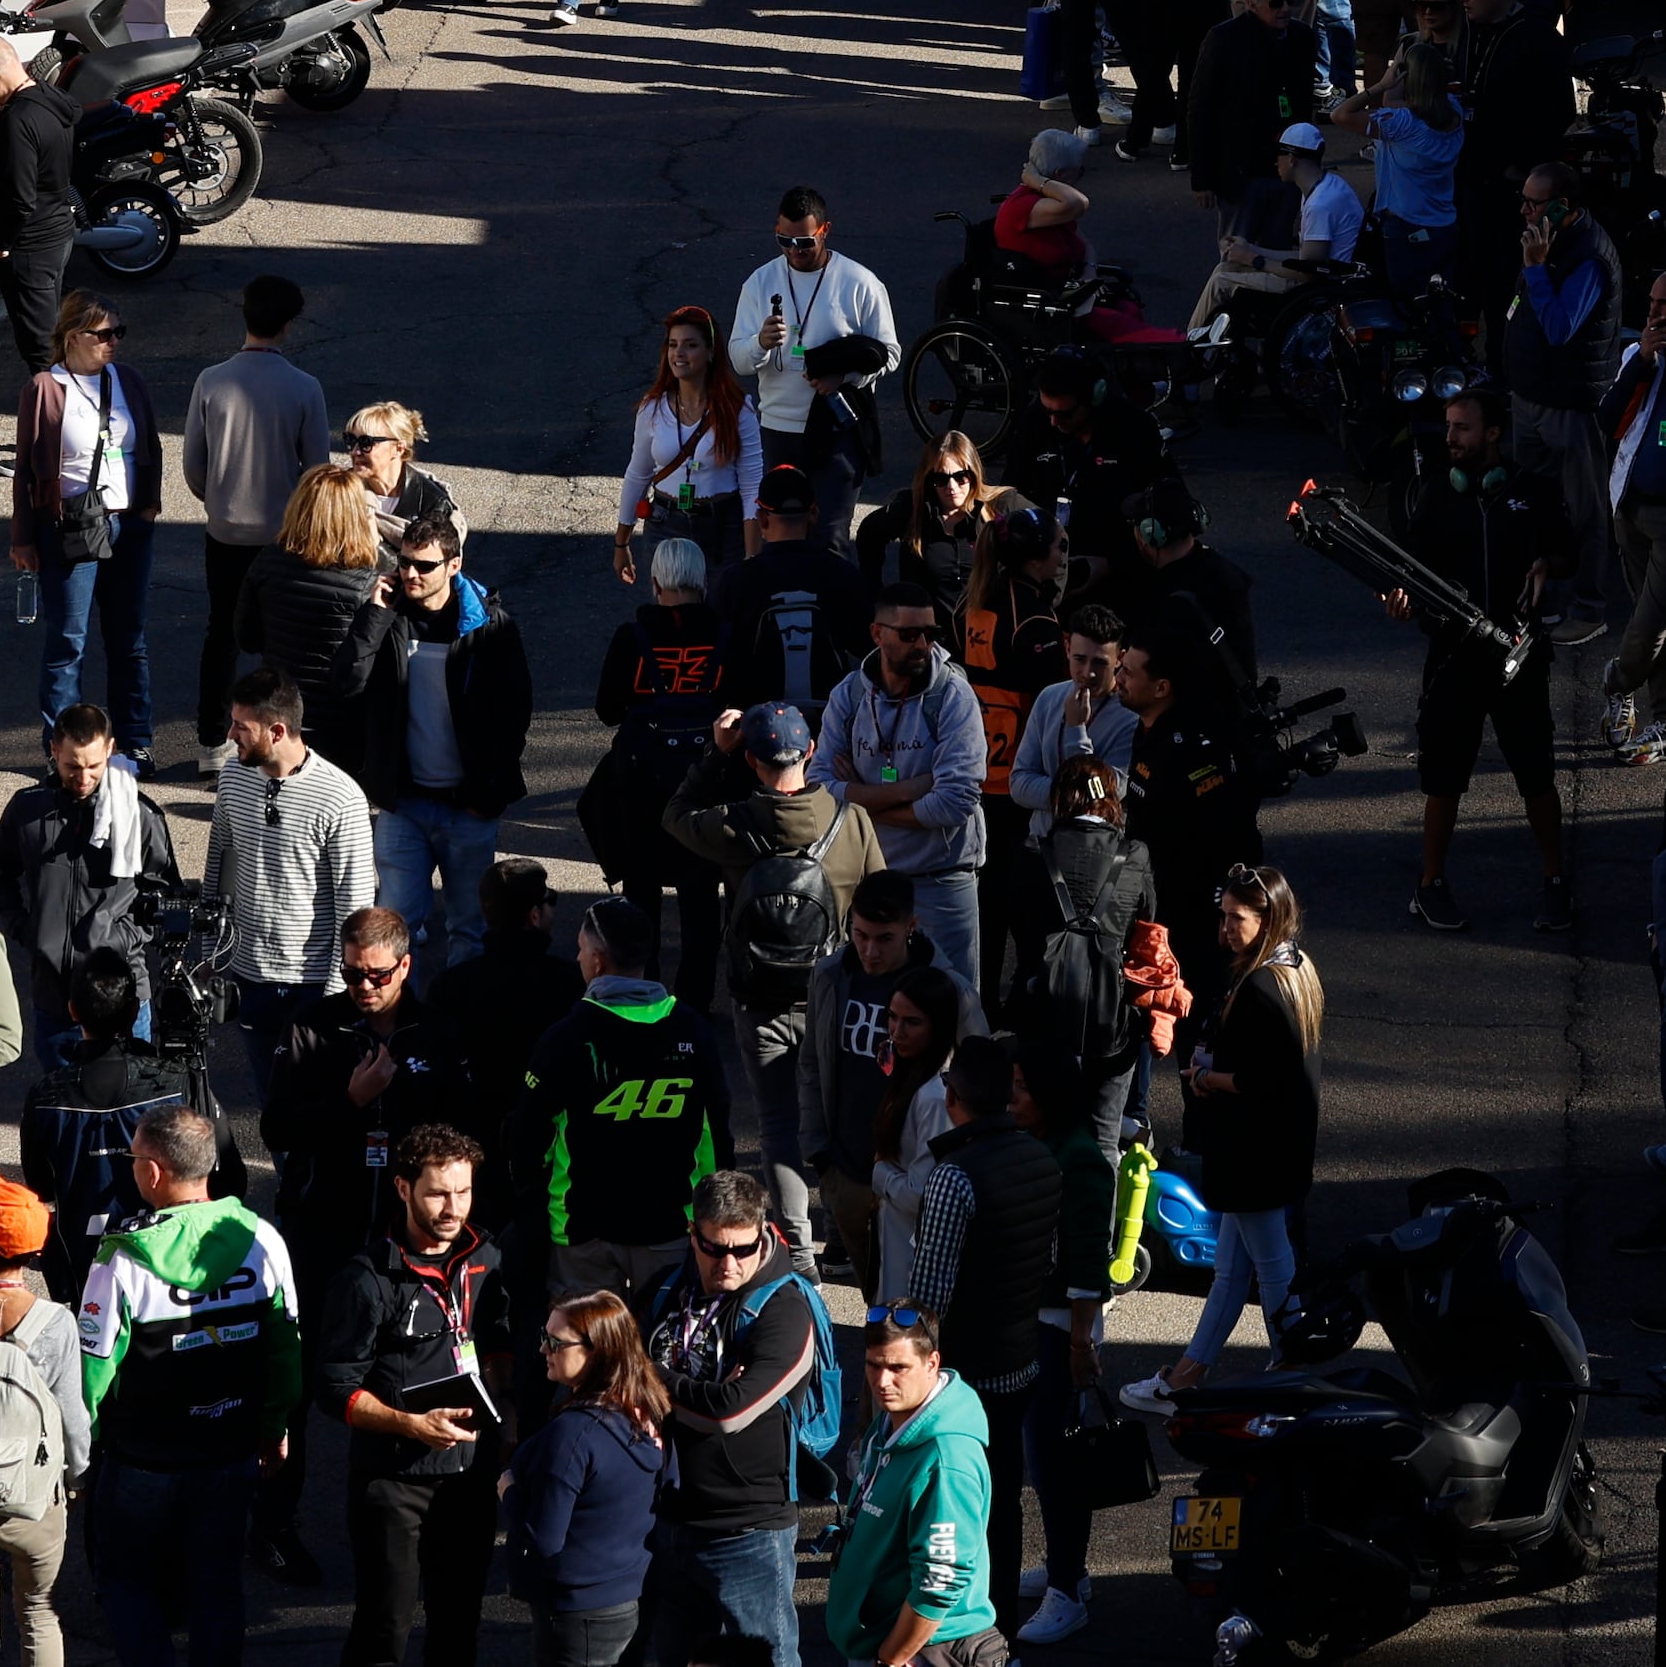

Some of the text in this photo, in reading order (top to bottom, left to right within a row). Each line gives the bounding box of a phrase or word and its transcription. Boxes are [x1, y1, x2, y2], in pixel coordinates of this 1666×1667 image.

[592, 1078, 694, 1122] 46
[175, 1322, 260, 1349] Green Power
[1197, 1500, 1223, 1522] 74
